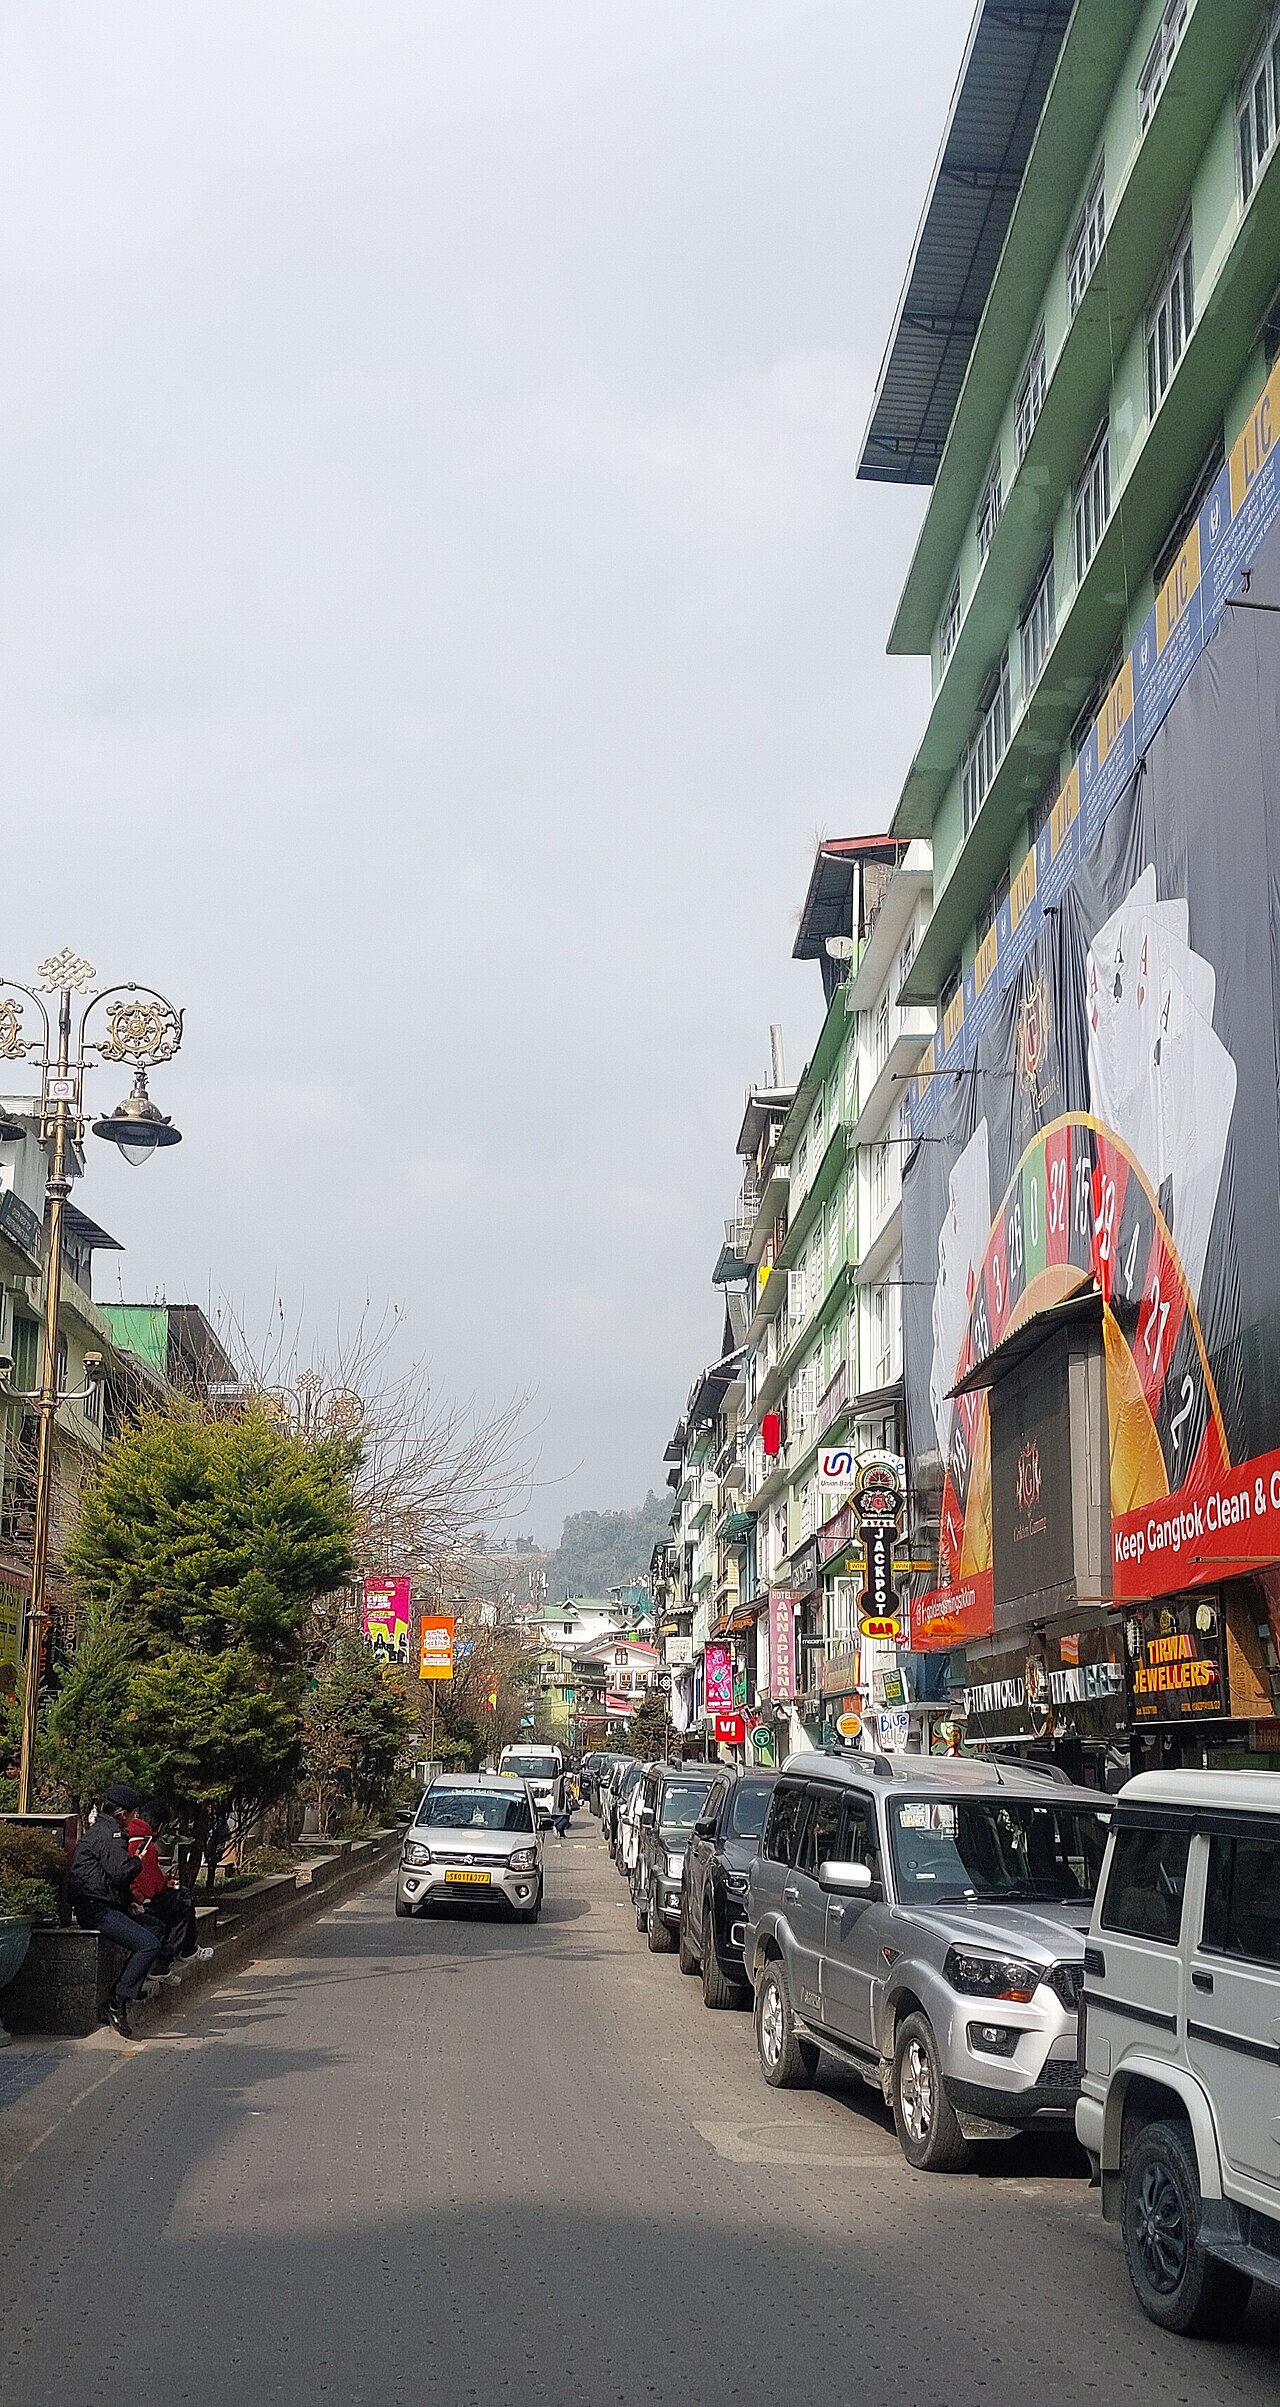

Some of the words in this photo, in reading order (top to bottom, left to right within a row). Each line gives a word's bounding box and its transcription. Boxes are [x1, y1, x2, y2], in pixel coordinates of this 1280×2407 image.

[1243, 394, 1271, 489] LIC
[1166, 554, 1187, 632] LIC
[1100, 687, 1124, 748] LIC
[1055, 785, 1073, 844] LIC
[1015, 863, 1033, 919] LIC
[979, 938, 993, 987] LIC
[1114, 925, 1124, 963] A
[1030, 1176, 1039, 1247] 0
[1049, 1157, 1067, 1235] 32
[1075, 1156, 1092, 1236] 15
[1008, 1202, 1023, 1283] 26
[1124, 1221, 1140, 1300] 4
[992, 1254, 1002, 1314] 3
[1170, 1374, 1194, 1450] 2
[1115, 1529, 1145, 1564] Keep
[1147, 1501, 1205, 1552] Gangtok
[1206, 1491, 1251, 1531] Clean
[1254, 1477, 1267, 1515] &
[772, 1591, 791, 1600] HOTEL
[873, 1527, 887, 1616] JACKPOT
[776, 1601, 790, 1698] ANNAPURNA
[868, 1622, 894, 1636] BAR
[1147, 1634, 1190, 1665] TIRWA
[995, 1677, 1025, 1711] WORLD
[1049, 1667, 1083, 1705] TITAN
[1133, 1660, 1213, 1694] JEWELLERS
